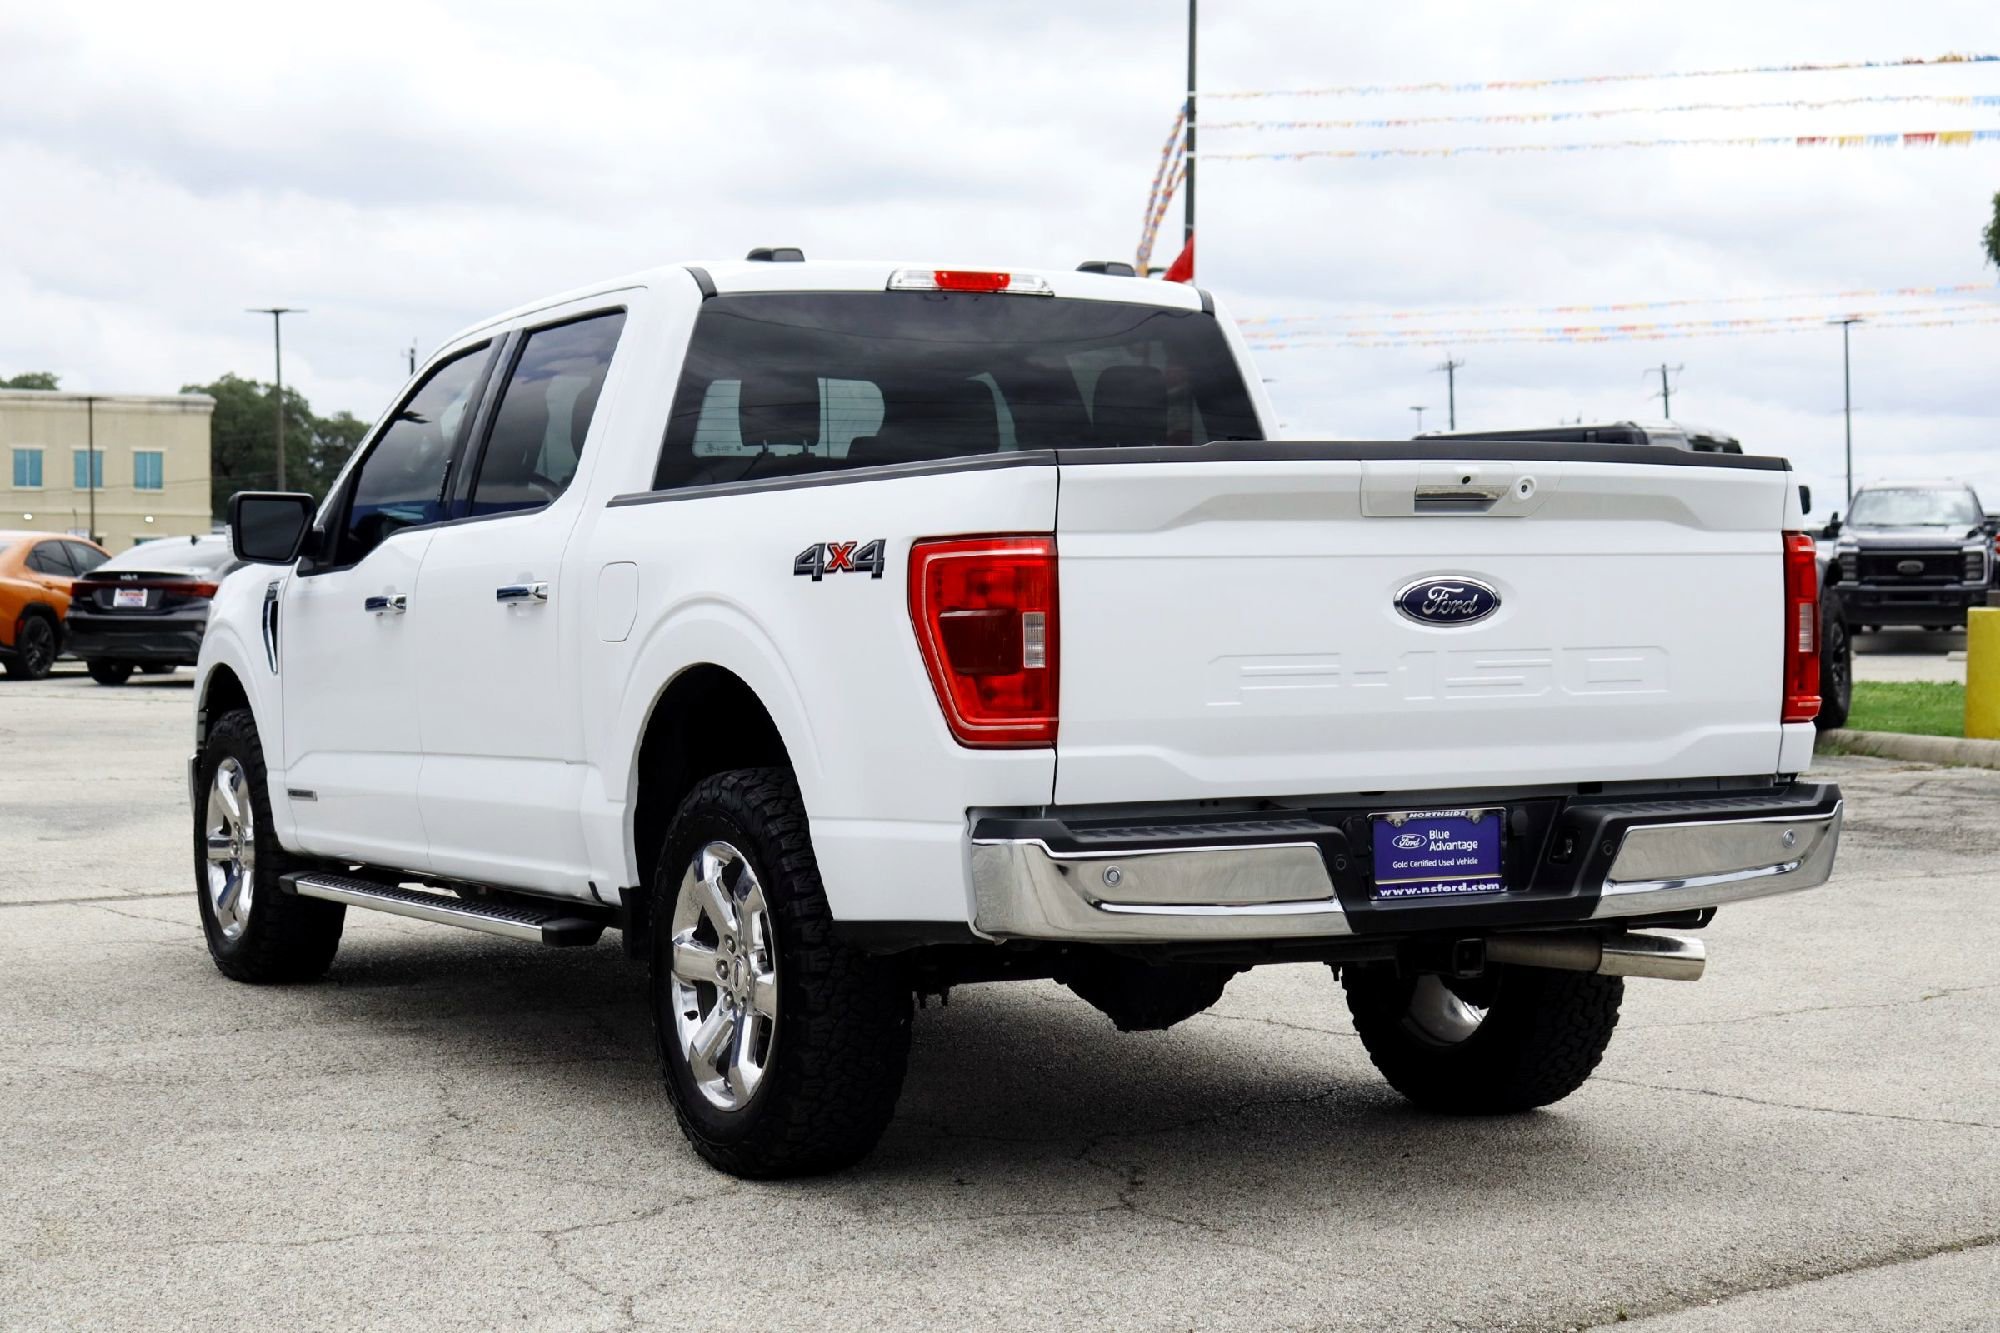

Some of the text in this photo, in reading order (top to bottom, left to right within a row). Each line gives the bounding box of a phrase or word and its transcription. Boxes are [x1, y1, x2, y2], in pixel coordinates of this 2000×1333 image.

[1421, 585, 1479, 615] Ford
[1205, 645, 1671, 707] F-150
[1408, 810, 1467, 818] NORTHSIDE
[1428, 829, 1450, 840] Blue
[1399, 835, 1421, 847] Ford
[1428, 840, 1479, 852] Advantage
[1392, 856, 1479, 869] Gold Certified Used Vehicle
[1379, 882, 1500, 897] www.nsford.com
